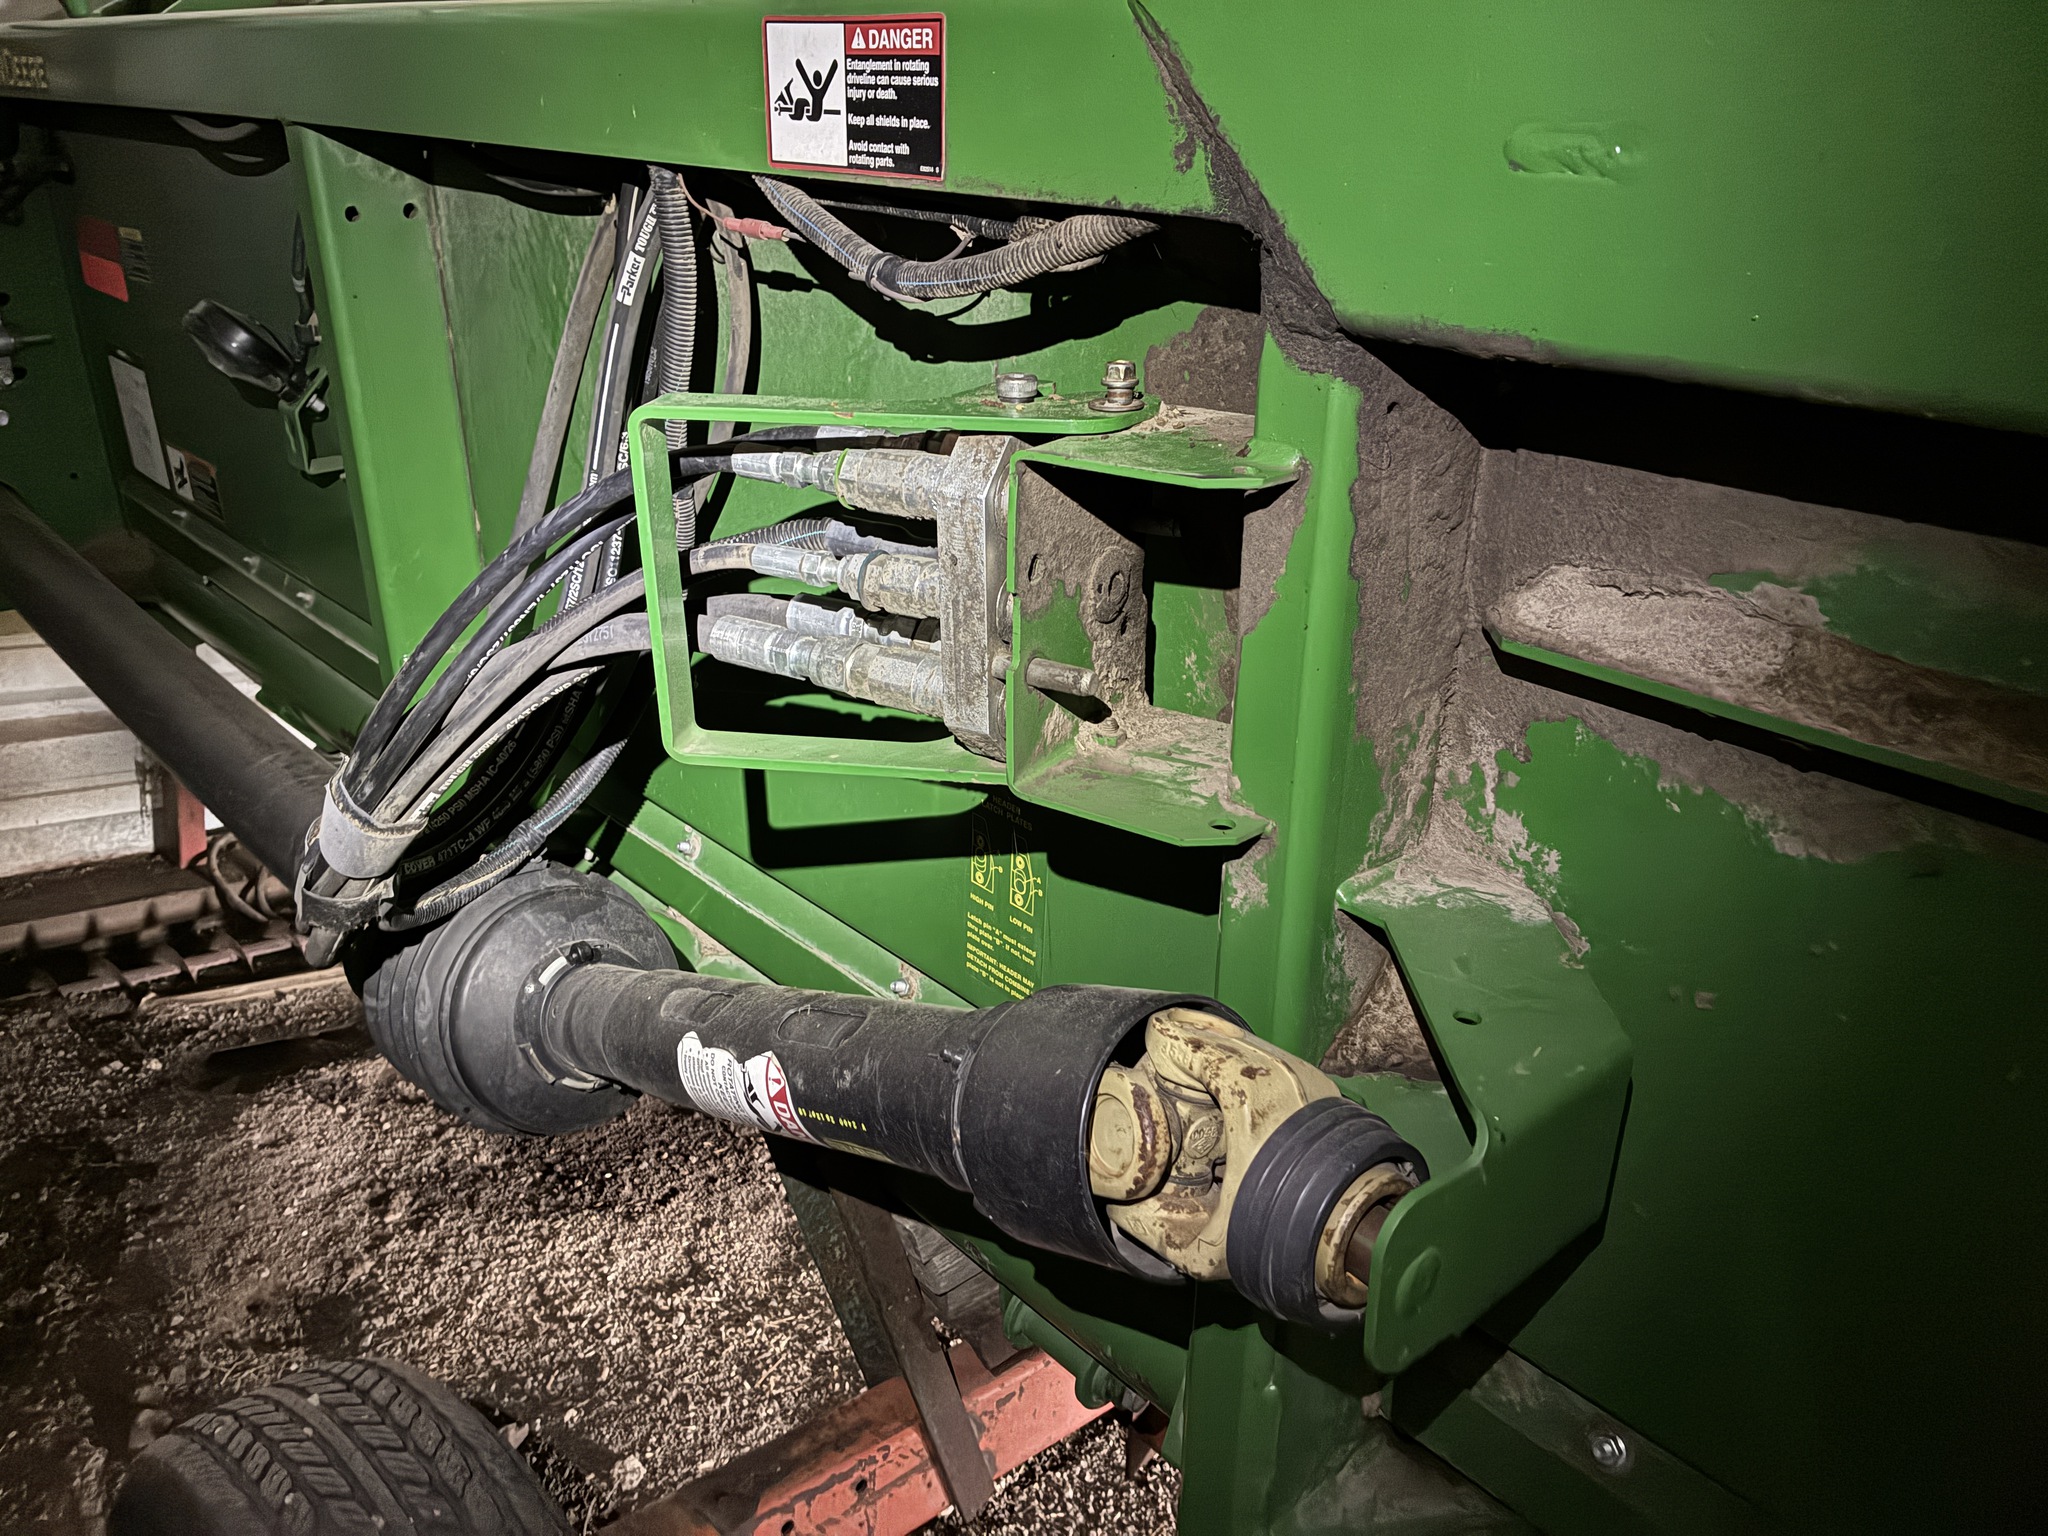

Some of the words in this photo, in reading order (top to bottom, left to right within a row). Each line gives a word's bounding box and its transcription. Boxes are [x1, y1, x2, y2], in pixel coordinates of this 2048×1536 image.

[868, 28, 934, 49] DANGER
[846, 58, 893, 73] Entanglement
[893, 58, 901, 71] in
[902, 59, 930, 74] rotating
[846, 72, 876, 85] driveline
[876, 75, 890, 85] can
[890, 75, 912, 86] cause
[912, 73, 939, 86] serious
[847, 86, 867, 101] injury
[867, 89, 876, 99] or
[876, 87, 898, 100] death.
[848, 113, 865, 128] Keep
[866, 113, 875, 126] all
[875, 114, 900, 128] shields
[901, 115, 908, 128] in
[909, 116, 931, 131] place.
[848, 139, 868, 152] Avoid
[869, 142, 895, 154] contact
[895, 143, 910, 155] with
[848, 154, 874, 169] rotating
[875, 156, 895, 169] parts.
[620, 257, 642, 303] Parker
[634, 214, 657, 253] TOUGH
[465, 774, 491, 802] MSHA
[970, 892, 984, 905] HIGH
[984, 901, 994, 911] PIN
[967, 911, 982, 925] Latch
[983, 922, 992, 931] pin
[1002, 933, 1017, 946] must
[1017, 942, 1037, 957] extend
[1009, 915, 1022, 927] LOW
[1023, 923, 1033, 934] PIN
[967, 930, 980, 943] plate
[967, 921, 979, 933] thru
[979, 928, 993, 941] plate
[1022, 954, 1035, 966] turn
[966, 942, 998, 967] IMPORTANT:
[999, 962, 1022, 981] HEADER
[1022, 976, 1035, 989] MAY
[966, 951, 988, 969] DETACH
[988, 965, 1004, 980] FROM
[1004, 975, 1031, 996] COMBINE
[966, 961, 979, 973] plate
[995, 980, 1004, 989] not
